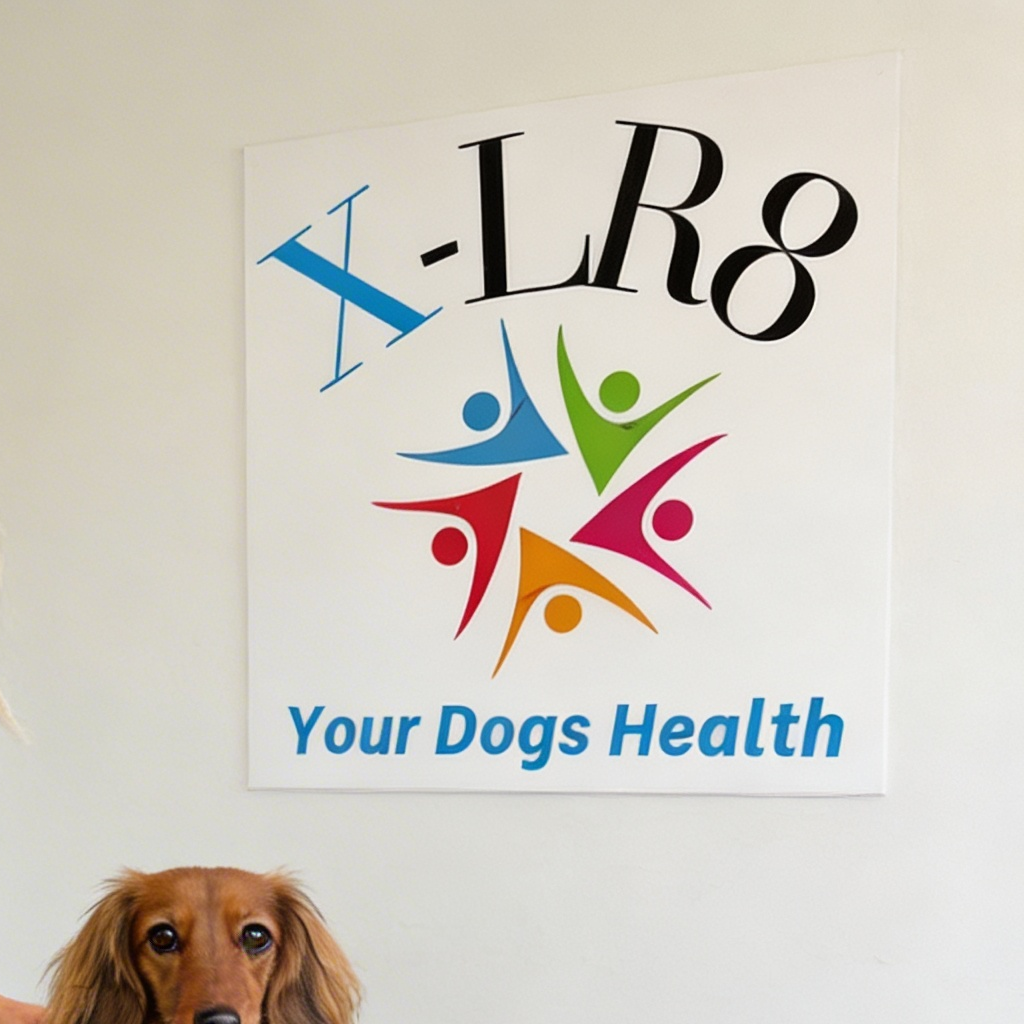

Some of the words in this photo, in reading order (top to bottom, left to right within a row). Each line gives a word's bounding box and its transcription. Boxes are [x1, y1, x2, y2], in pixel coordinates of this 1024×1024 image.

[256, 119, 859, 393] X-LR8
[288, 705, 422, 755] Your
[435, 705, 591, 771] Dogs
[609, 696, 845, 758] Health
